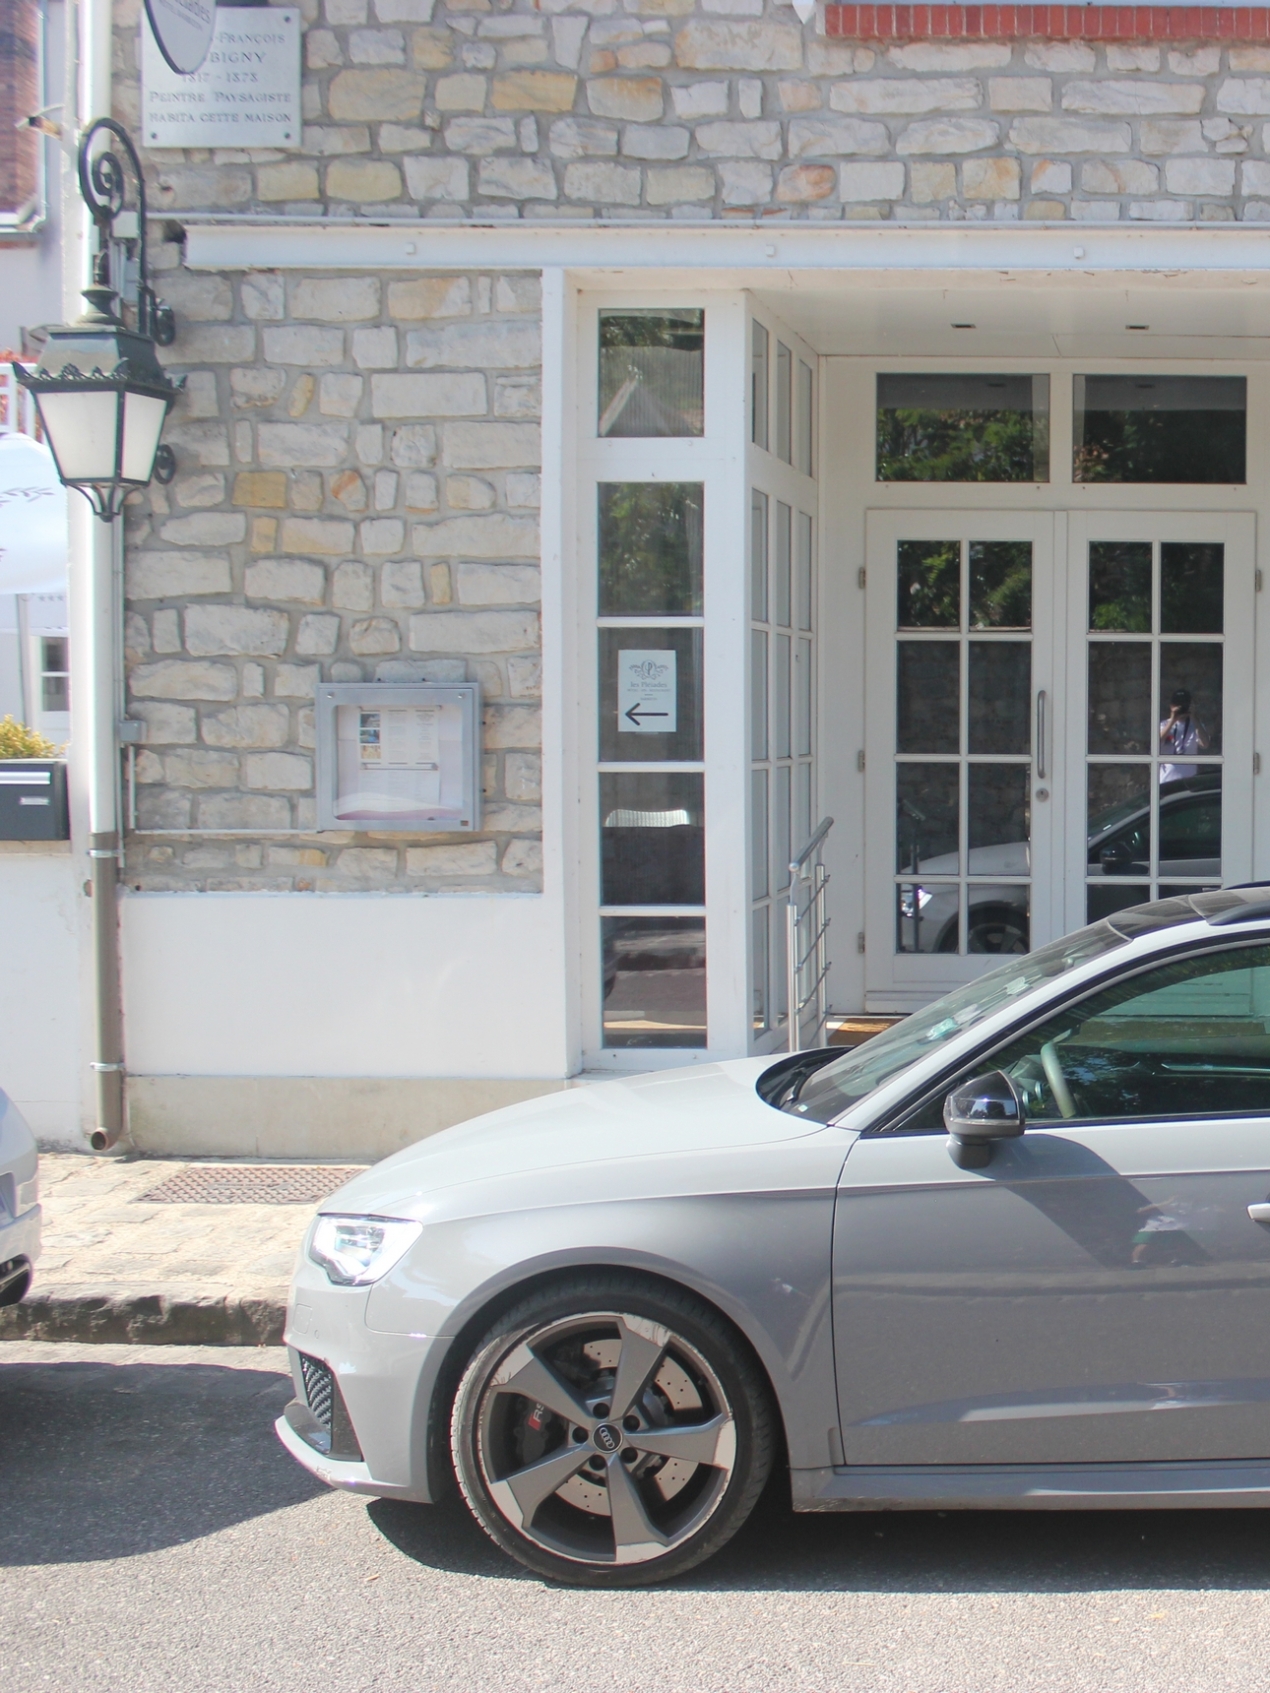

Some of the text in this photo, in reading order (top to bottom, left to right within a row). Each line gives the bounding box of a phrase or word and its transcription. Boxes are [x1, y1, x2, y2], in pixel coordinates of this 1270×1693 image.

[210, 51, 267, 64] BIGNY
[199, 112, 240, 123] CETTE
[244, 112, 292, 123] MAISON
